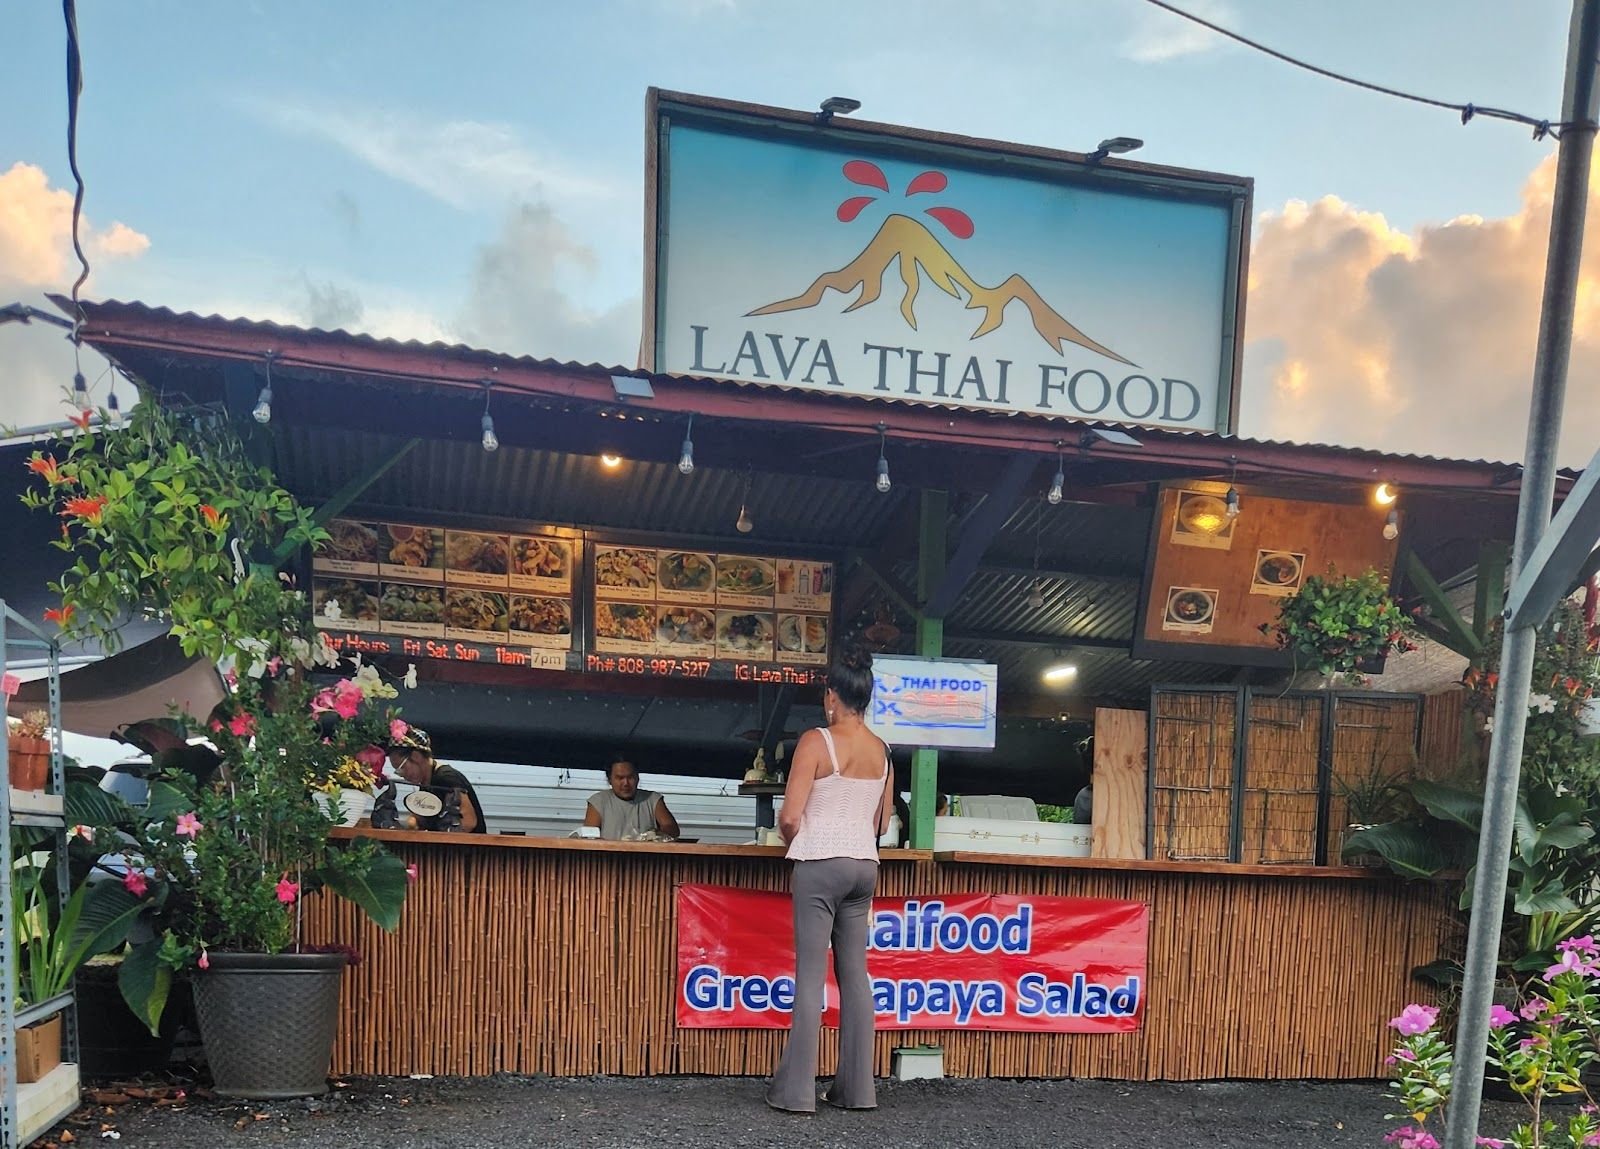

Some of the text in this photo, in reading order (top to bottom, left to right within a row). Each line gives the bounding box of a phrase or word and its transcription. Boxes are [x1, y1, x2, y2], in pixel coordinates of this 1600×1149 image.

[689, 325, 1202, 424] LAVA THAI FOOD
[455, 643, 480, 661] Sun
[587, 655, 710, 678] Ph# 808-987-5217
[753, 665, 782, 683] Lava
[901, 676, 982, 692] THAI FOOD
[684, 966, 1140, 1025] Gree apaya Salad
